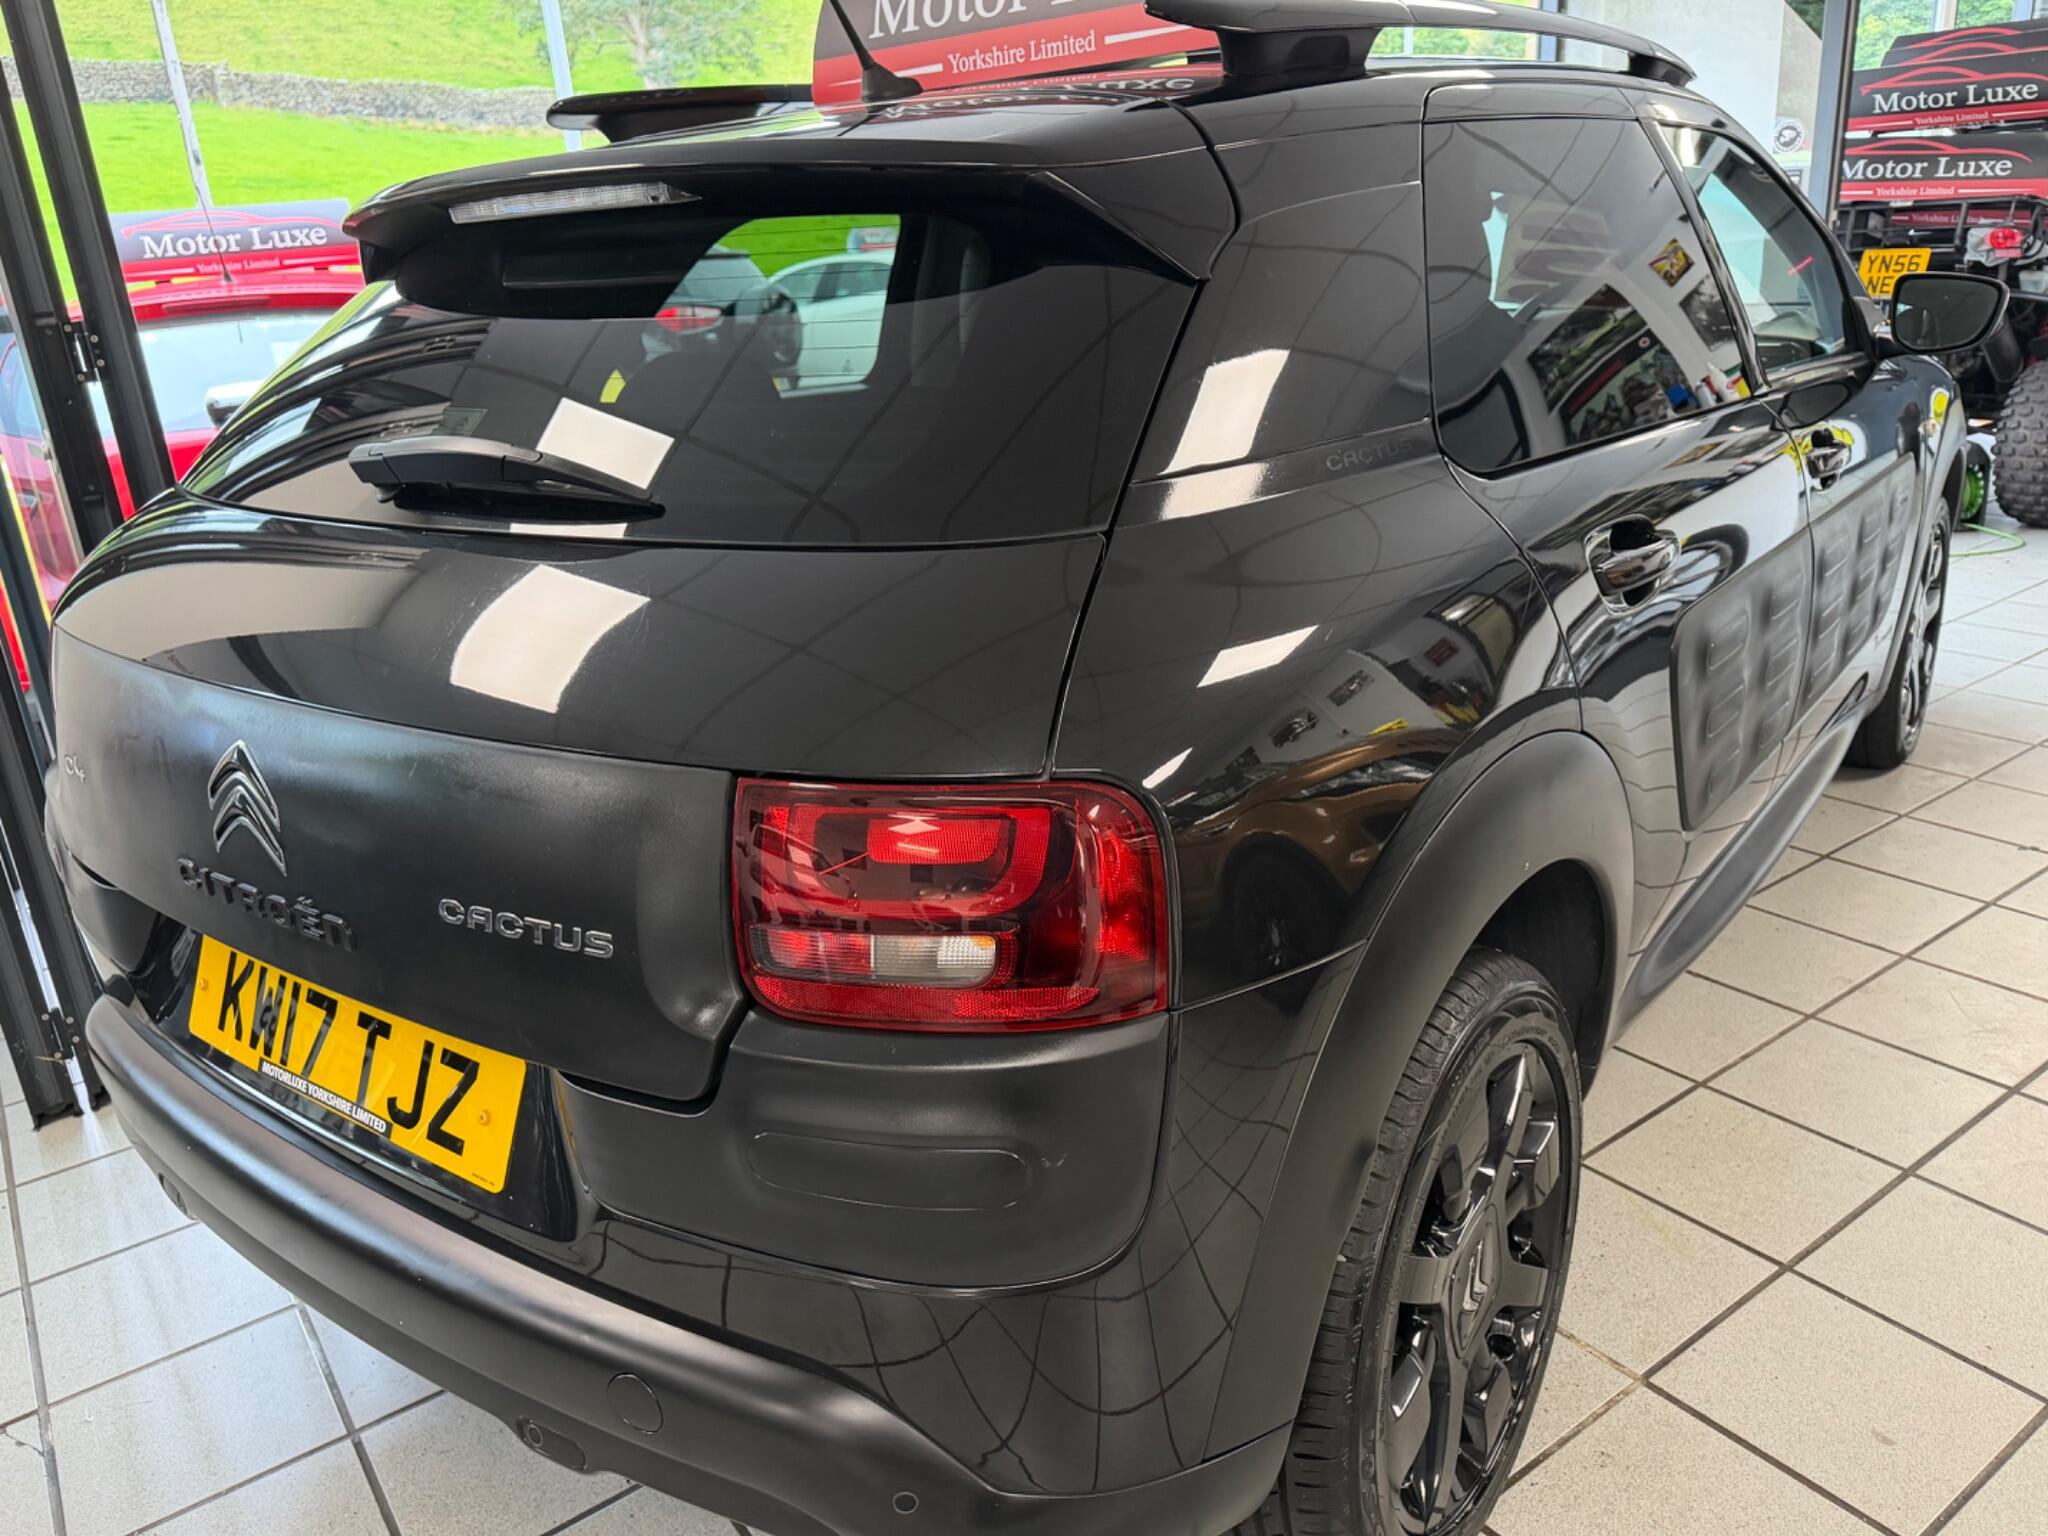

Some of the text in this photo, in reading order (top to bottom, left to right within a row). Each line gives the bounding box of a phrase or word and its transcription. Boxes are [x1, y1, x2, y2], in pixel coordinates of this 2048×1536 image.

[947, 29, 1096, 73] Yorkshire Limited
[1871, 83, 2039, 113] Motor Luxe
[1914, 111, 1990, 125] Yorkshire Limited
[1842, 156, 2013, 180] Motor Luxe
[1876, 185, 1955, 196] Yorkshire Limited
[139, 225, 328, 259] Motor Luxe
[1868, 254, 1922, 273] YN56
[1866, 276, 1895, 294] NE
[64, 755, 87, 785] C4
[437, 897, 616, 960] CACTUS
[217, 950, 480, 1157] KW17 TJZ
[261, 1060, 387, 1134] MOTORLUXE YORKSHIRE LIMITED
